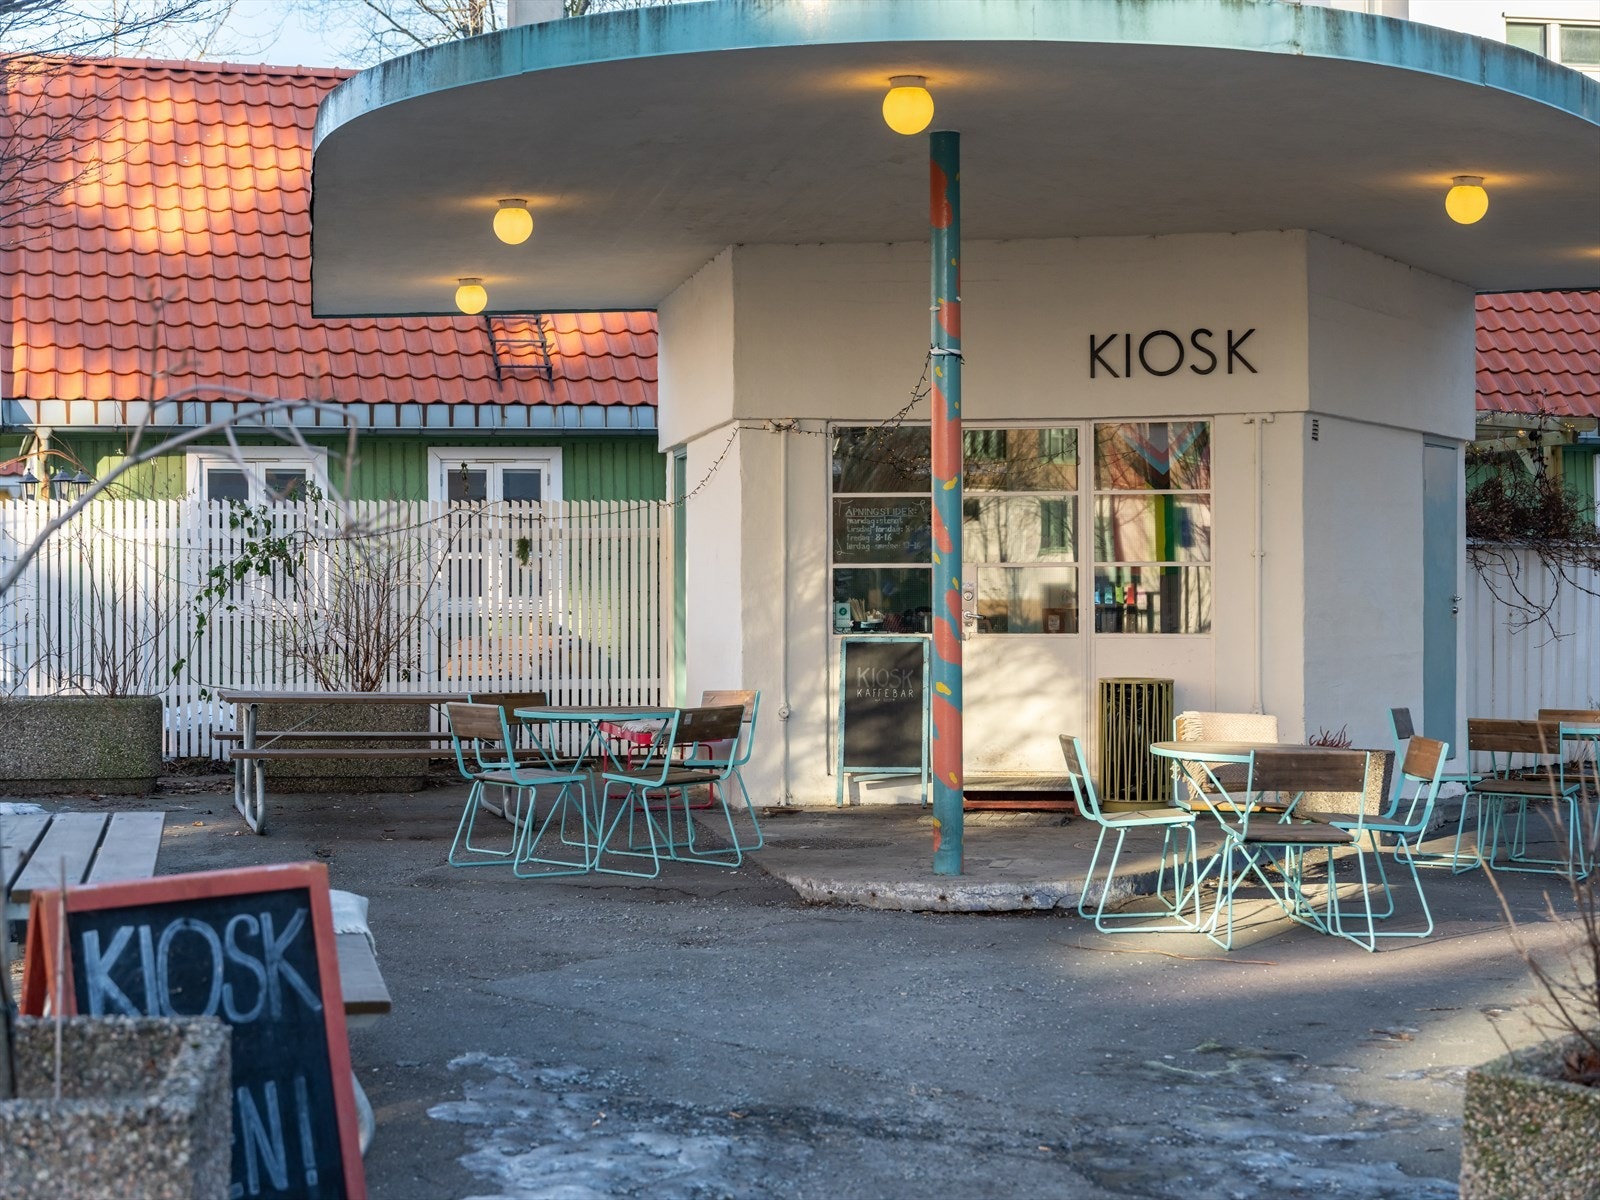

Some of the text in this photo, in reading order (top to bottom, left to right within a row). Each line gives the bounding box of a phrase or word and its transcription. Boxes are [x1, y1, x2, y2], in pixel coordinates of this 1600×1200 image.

[1089, 328, 1258, 379] KIOSK
[845, 505, 918, 517] ÅPNINGSTIDER:
[856, 666, 914, 689] KIOSK
[856, 688, 914, 698] KAFFEBAR
[81, 908, 324, 1024] KIOSK
